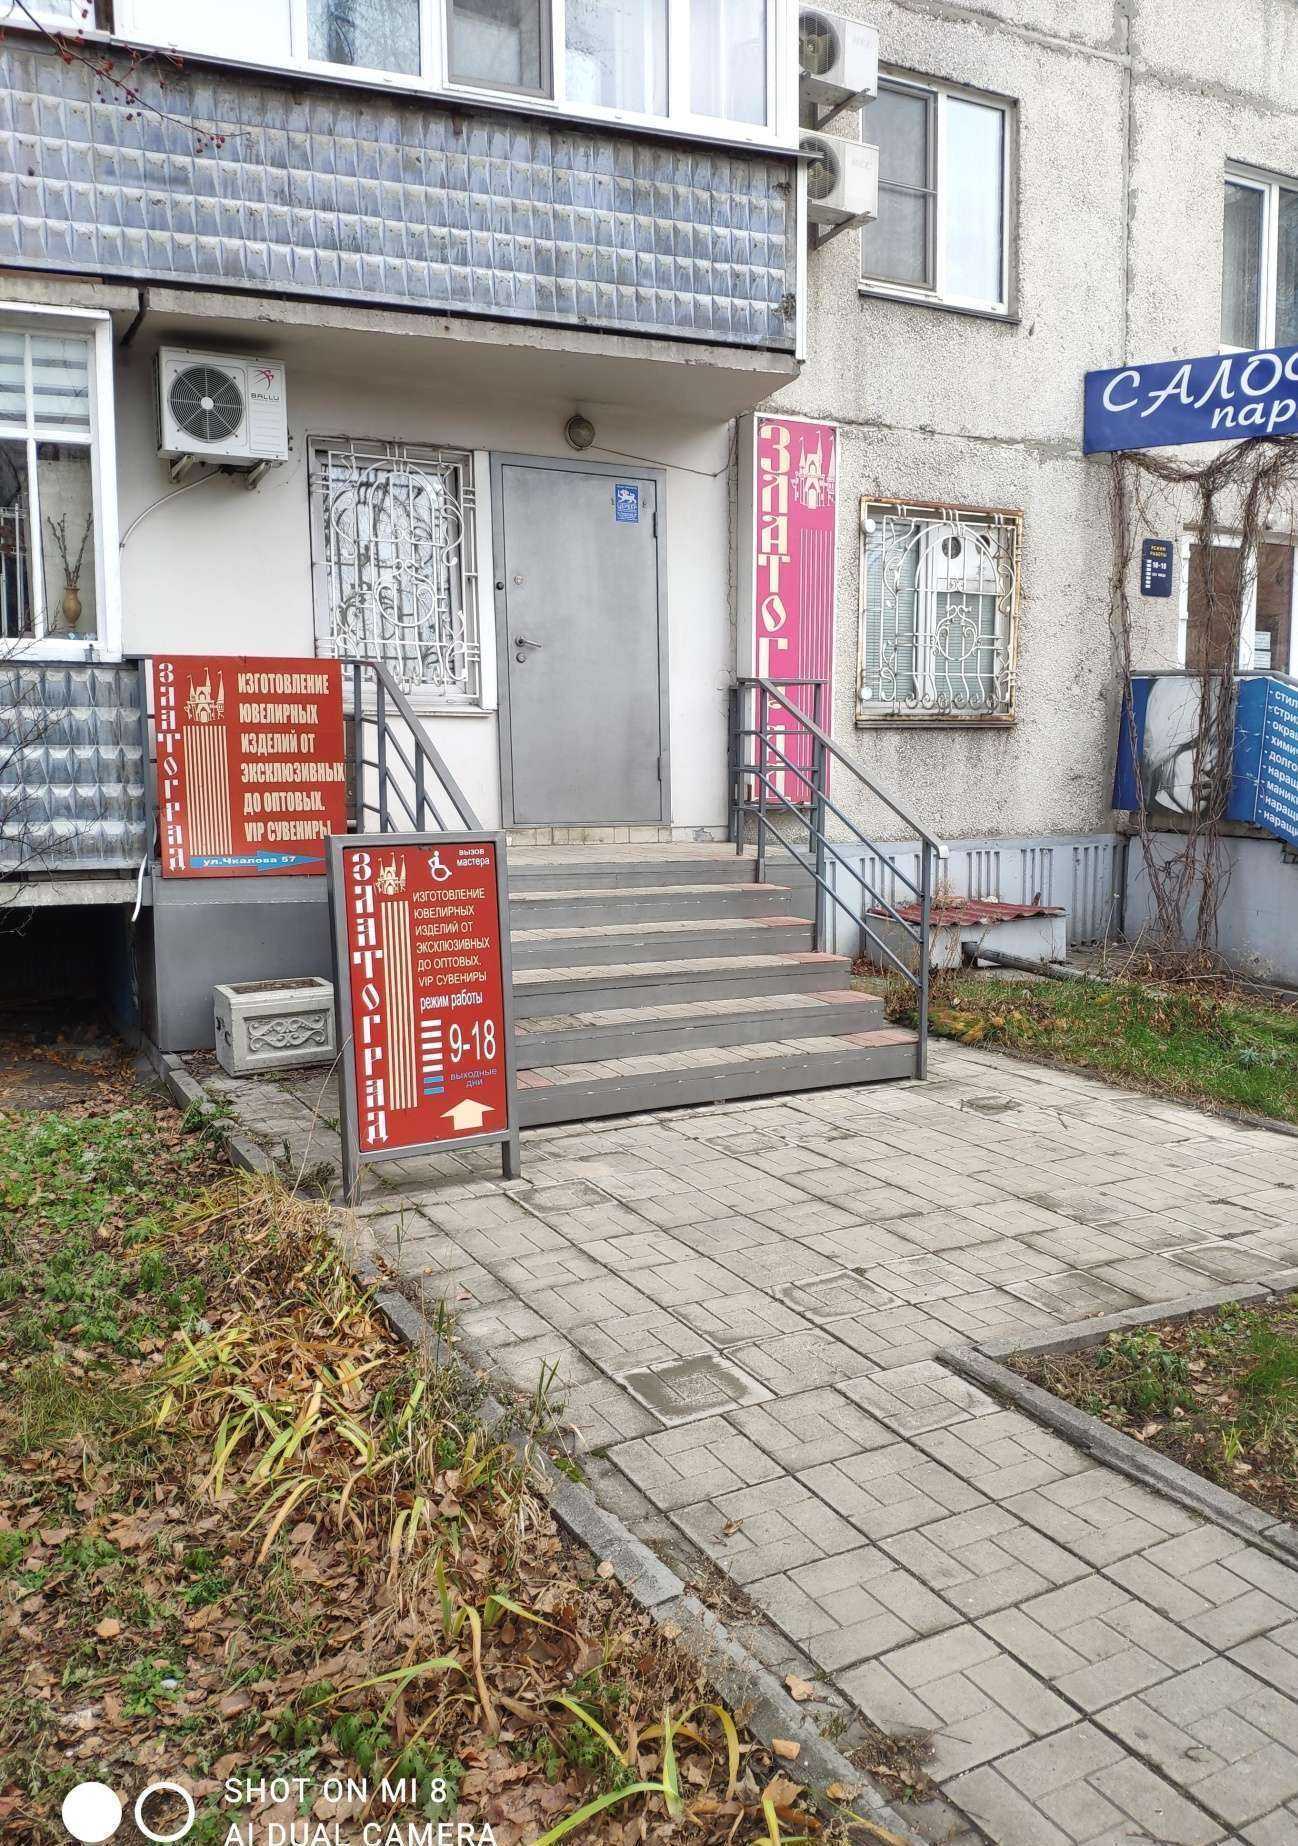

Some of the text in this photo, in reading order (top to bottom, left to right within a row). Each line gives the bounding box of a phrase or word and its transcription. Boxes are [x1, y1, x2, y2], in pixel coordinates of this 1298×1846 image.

[250, 392, 280, 402] BALLU
[1211, 399, 1297, 433] пар
[237, 672, 329, 695] ИЗГОТОВЛЕНИЕ
[239, 703, 319, 725] ЮВЕЛИРНЫХ
[1273, 706, 1298, 724] стри
[1272, 721, 1298, 740] окра
[241, 729, 315, 756] ИЗДЕЛИЙ ОТ
[1271, 735, 1298, 755] хими
[240, 762, 345, 783] ЭКСКЛЮЗИВНЫХ
[1266, 781, 1298, 805] маник
[243, 791, 326, 815] ДО ОПТОВЫХ.
[1265, 795, 1298, 822] наращ
[244, 820, 332, 841] VIP СУВЕНИРЫ
[282, 855, 297, 864] 57
[458, 848, 485, 856] вызов
[456, 857, 490, 867] мастера
[412, 888, 485, 903] ИЗГОТОВЛЕНИЕ
[414, 905, 475, 919] ЮВЕЛИРНЫХ
[415, 921, 473, 937] ИЗДЕЛИЙ ОТ
[416, 936, 490, 954] ЭКСКЛЮЗИВНЫХ
[417, 955, 482, 971] ДО ОПТОВЫХ.
[418, 971, 487, 987] VIP СУВЕНИРЫ
[420, 989, 483, 1014] режим работы
[449, 1018, 496, 1063] 9-18
